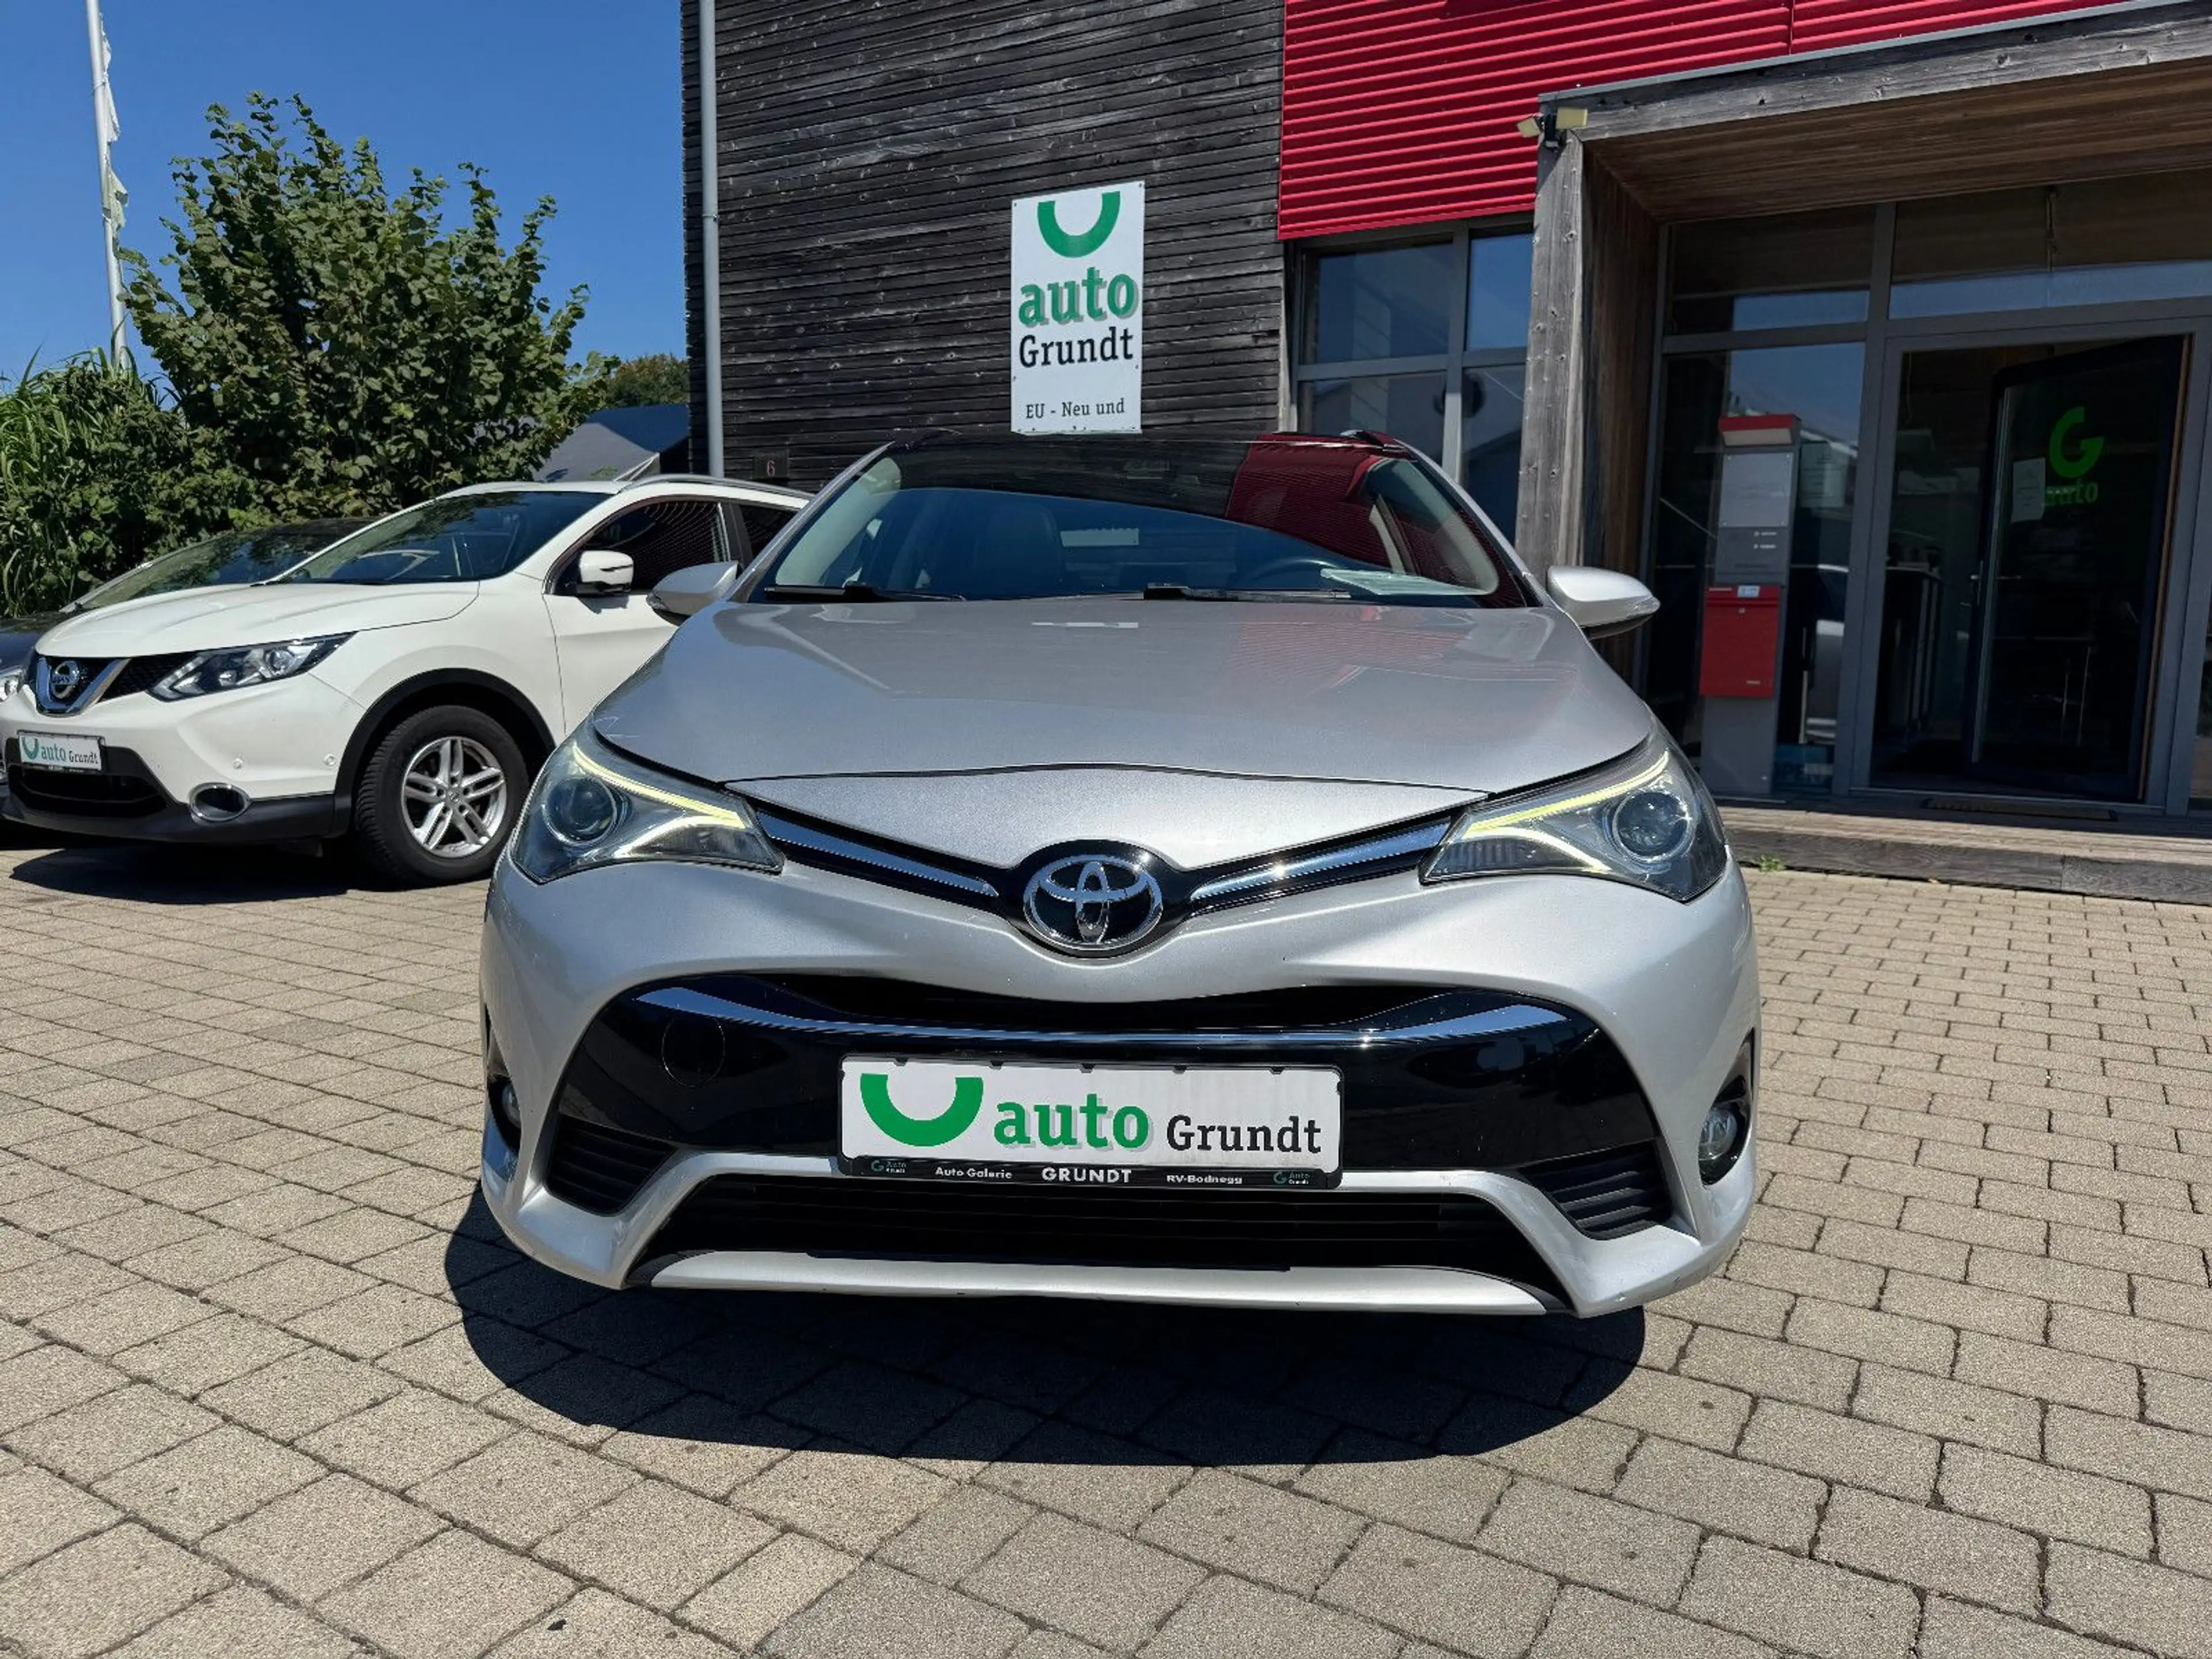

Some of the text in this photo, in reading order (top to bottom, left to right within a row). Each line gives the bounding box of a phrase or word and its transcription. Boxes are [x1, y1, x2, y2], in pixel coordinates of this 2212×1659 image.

[1018, 267, 1139, 327] auto
[1020, 327, 1134, 368] Grundt
[1026, 404, 1045, 419] EU
[1062, 402, 1090, 416] Neu
[1096, 397, 1125, 414] und
[767, 460, 776, 478] 6
[41, 744, 66, 762] auto
[994, 1093, 1321, 1153] auto Grundt
[935, 1166, 1013, 1179] Auto Galerie
[1041, 1167, 1132, 1184] GRUNDT
[1166, 1175, 1243, 1184] RV-Bodnegg
